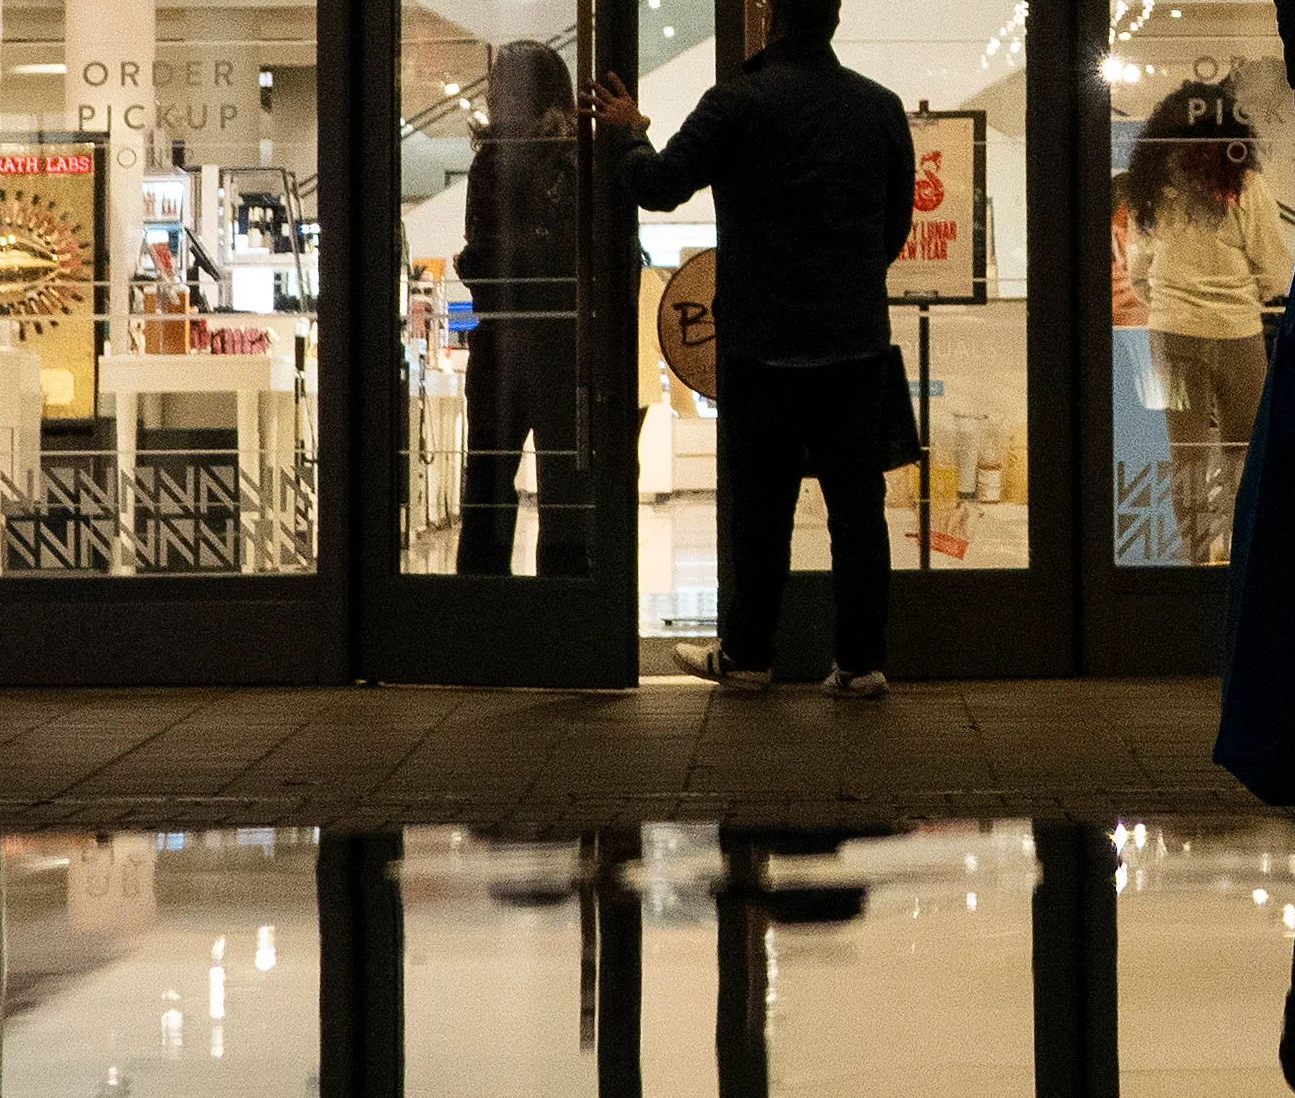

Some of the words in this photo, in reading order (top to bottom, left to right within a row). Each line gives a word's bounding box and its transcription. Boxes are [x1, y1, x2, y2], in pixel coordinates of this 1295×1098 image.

[83, 61, 234, 87] ORDER
[78, 104, 238, 131] PICKUP
[45, 156, 91, 173] LABS
[921, 240, 948, 260] YEAR
